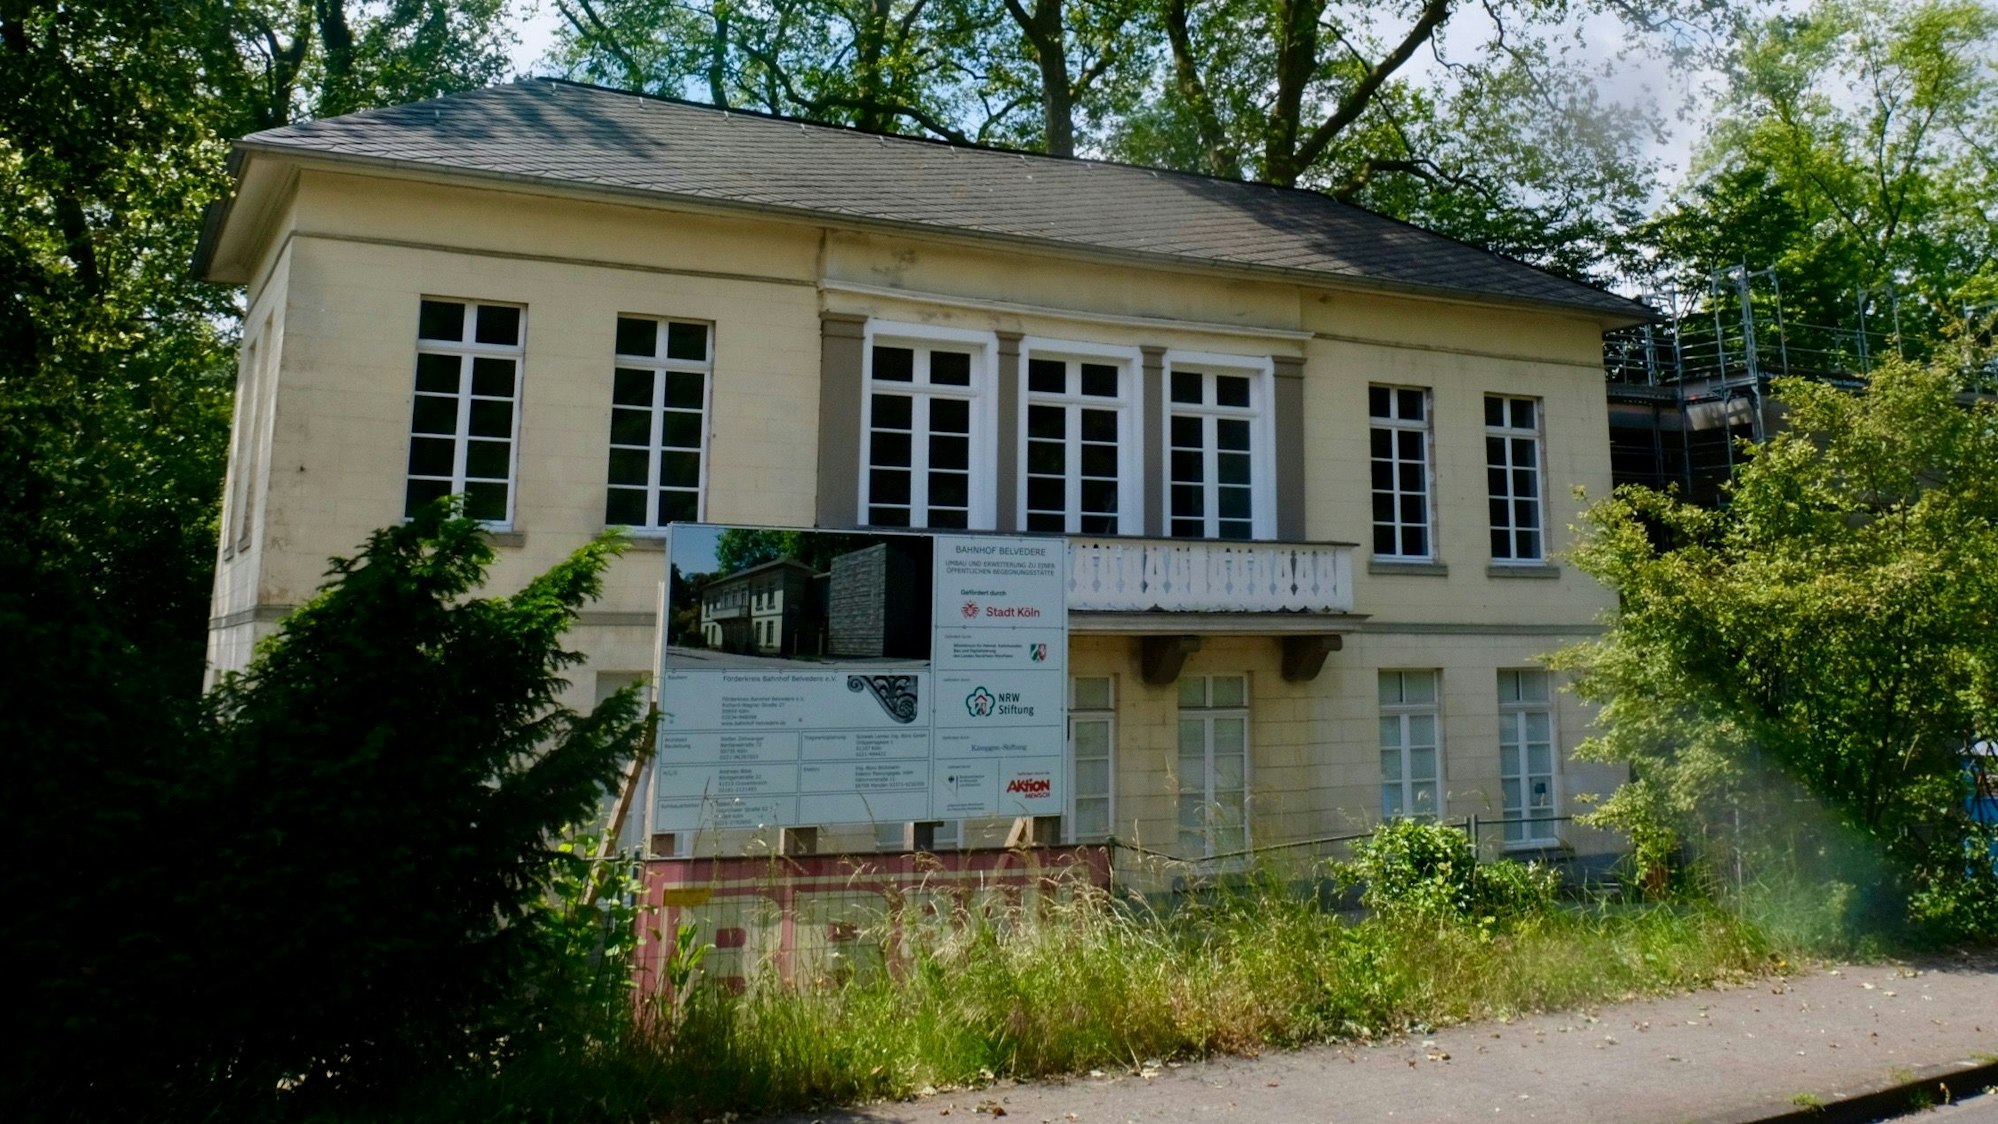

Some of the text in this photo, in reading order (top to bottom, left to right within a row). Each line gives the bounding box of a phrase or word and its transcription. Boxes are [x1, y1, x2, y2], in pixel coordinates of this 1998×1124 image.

[956, 546, 1046, 556] BAHNHOF BELVEDERE
[986, 606, 1040, 618] Stadt Köln
[999, 693, 1020, 703] NRW
[999, 705, 1034, 716] Stiftung
